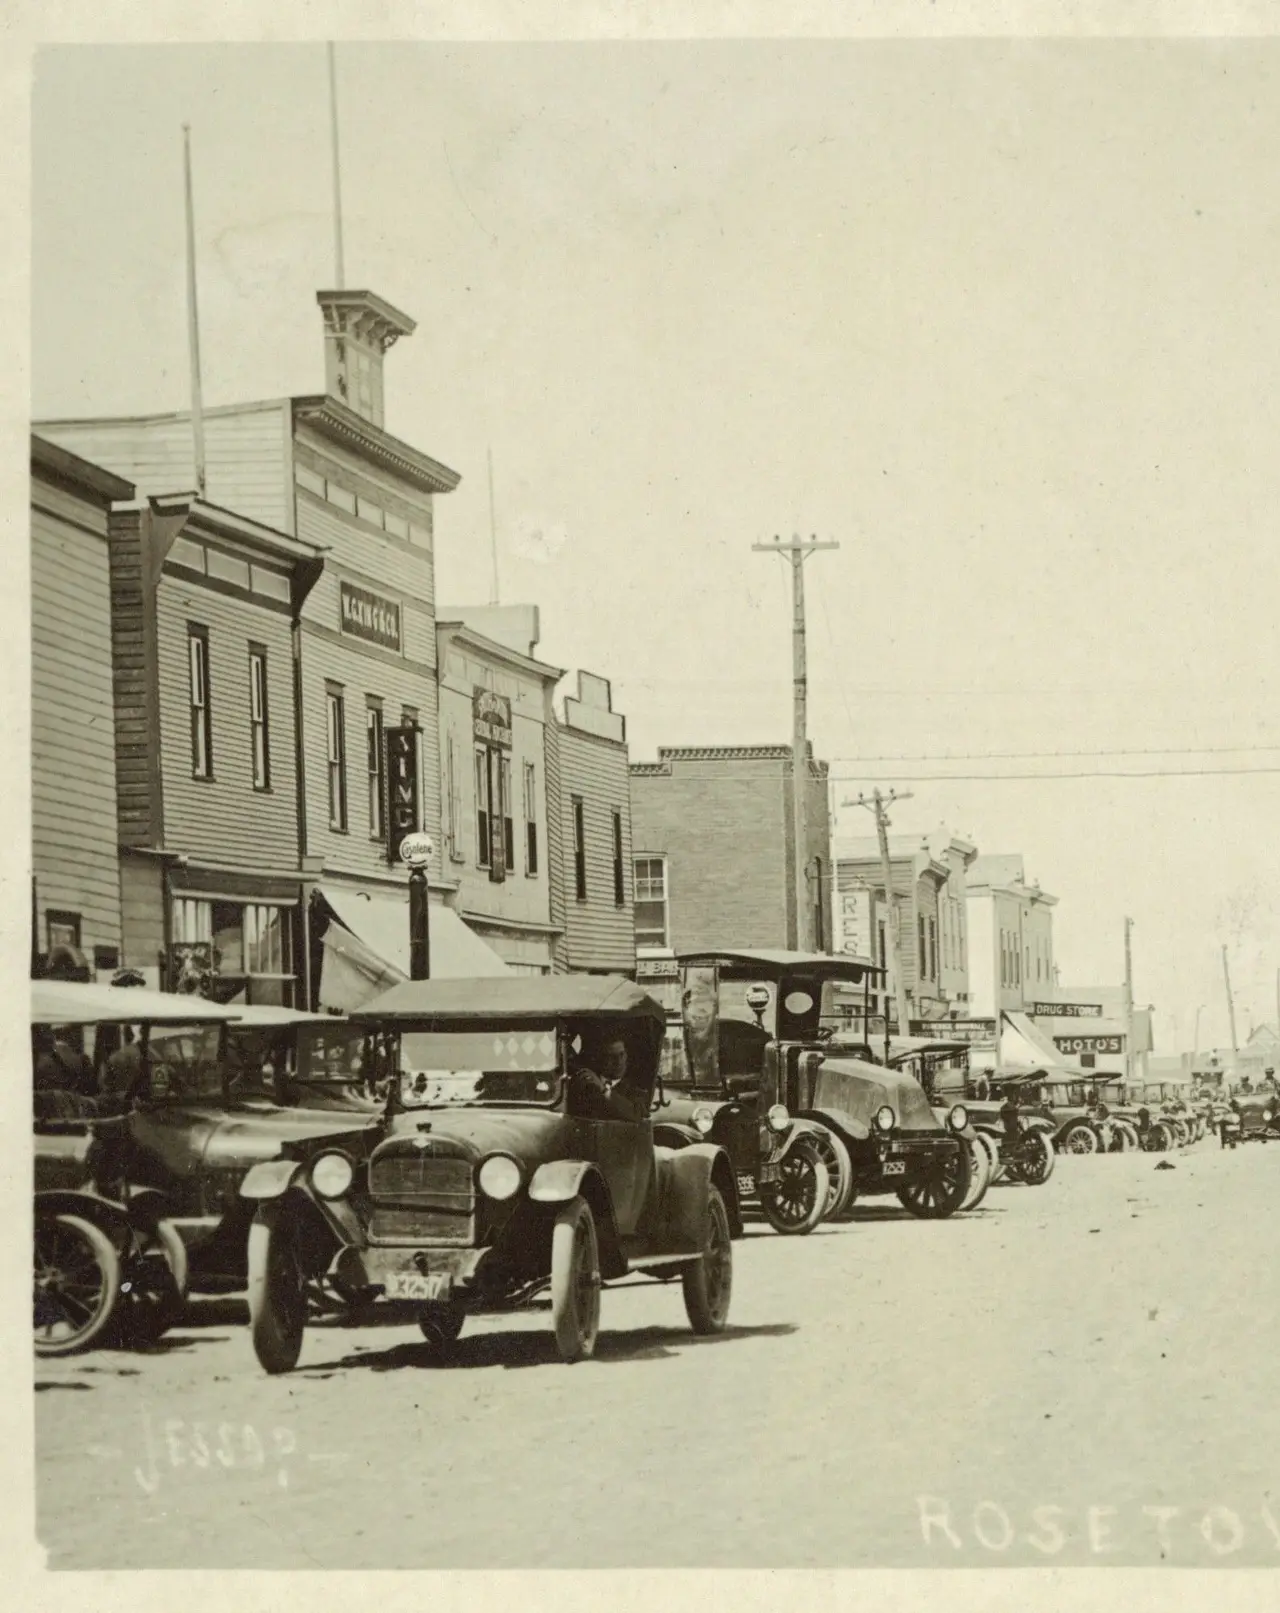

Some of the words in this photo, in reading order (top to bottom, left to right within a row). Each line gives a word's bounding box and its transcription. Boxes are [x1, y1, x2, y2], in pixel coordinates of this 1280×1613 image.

[1036, 1004, 1063, 1015] DRUG
[1065, 1006, 1099, 1017] STORE
[1053, 1038, 1119, 1052] HOTO'S
